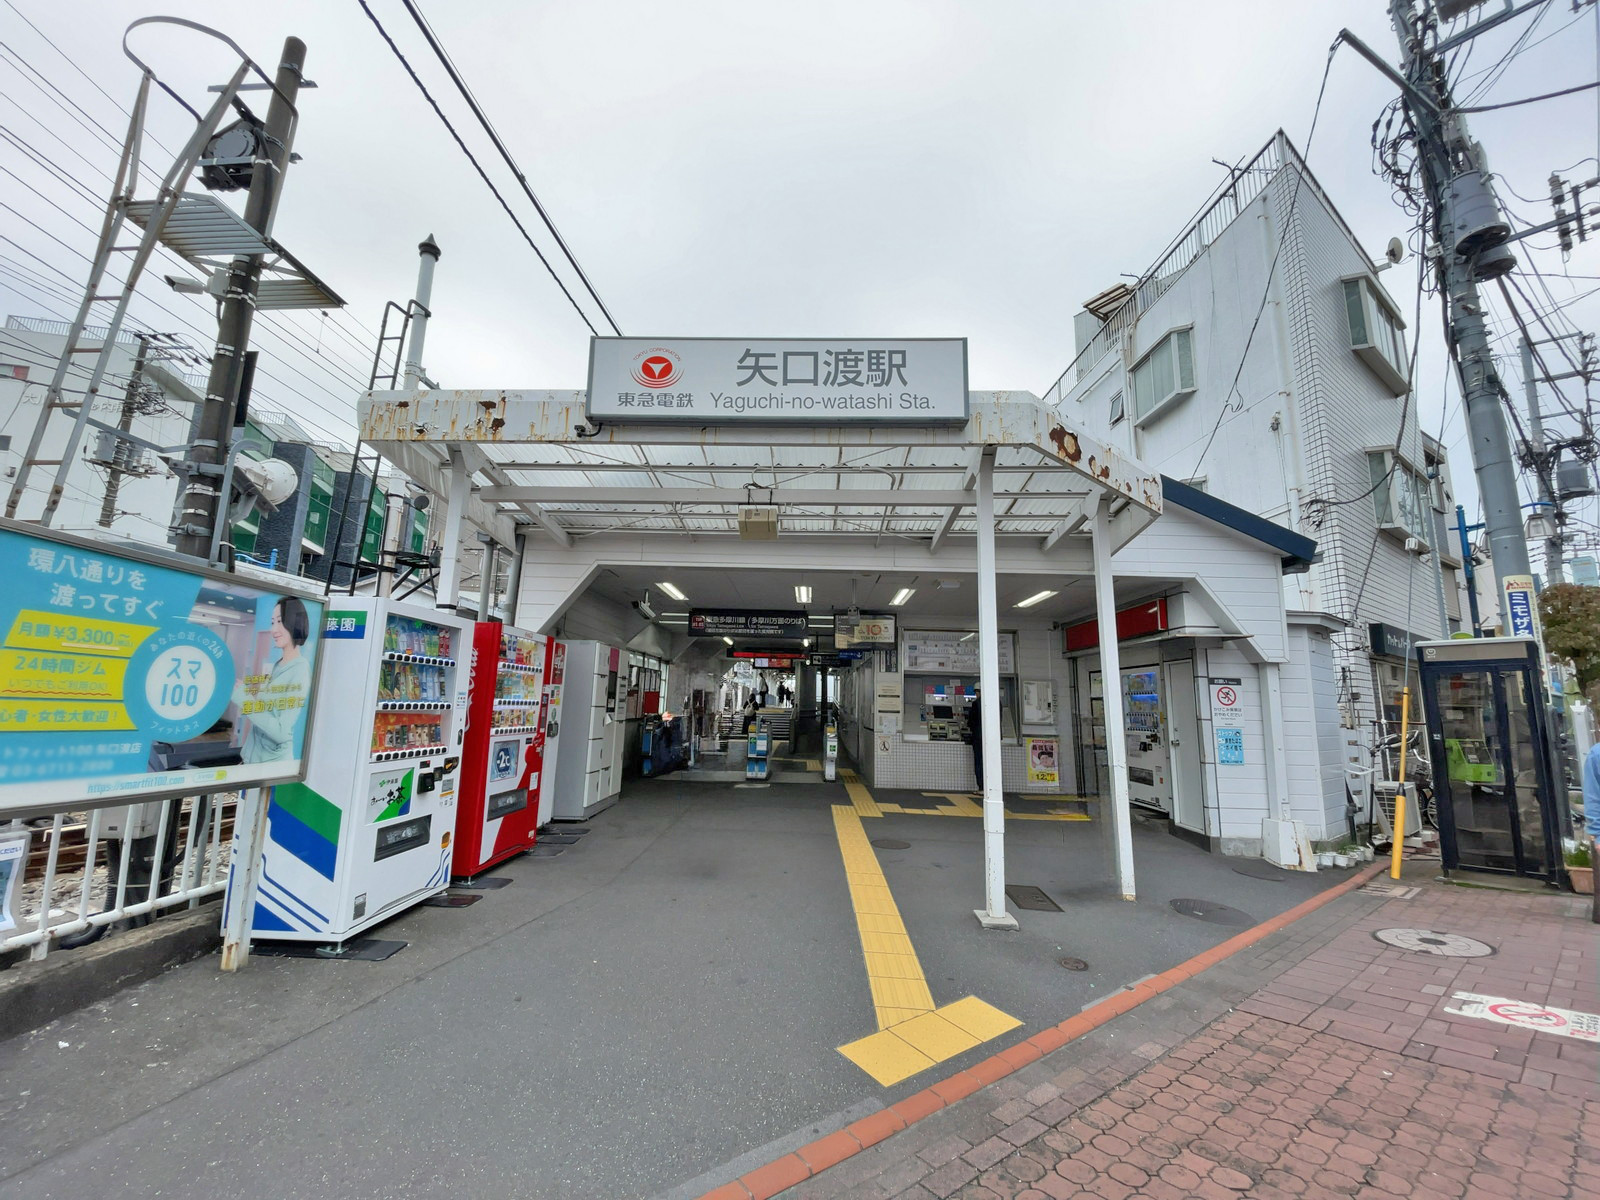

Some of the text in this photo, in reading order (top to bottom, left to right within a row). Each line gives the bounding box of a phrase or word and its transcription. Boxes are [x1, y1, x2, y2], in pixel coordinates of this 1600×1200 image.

[649, 347, 681, 362] CORPORATION
[736, 347, 908, 388] 矢口渡駅
[617, 392, 694, 408] 東急電鉄
[710, 392, 936, 412] Yaguchi-no-watashi Sta.
[28, 547, 147, 591] 環八通りを
[50, 582, 164, 620] 渡ってすぐ
[14, 655, 107, 676] 24時間ジム
[166, 657, 203, 680] スマ
[160, 683, 199, 706] 100
[241, 696, 305, 715] 運動が日常に
